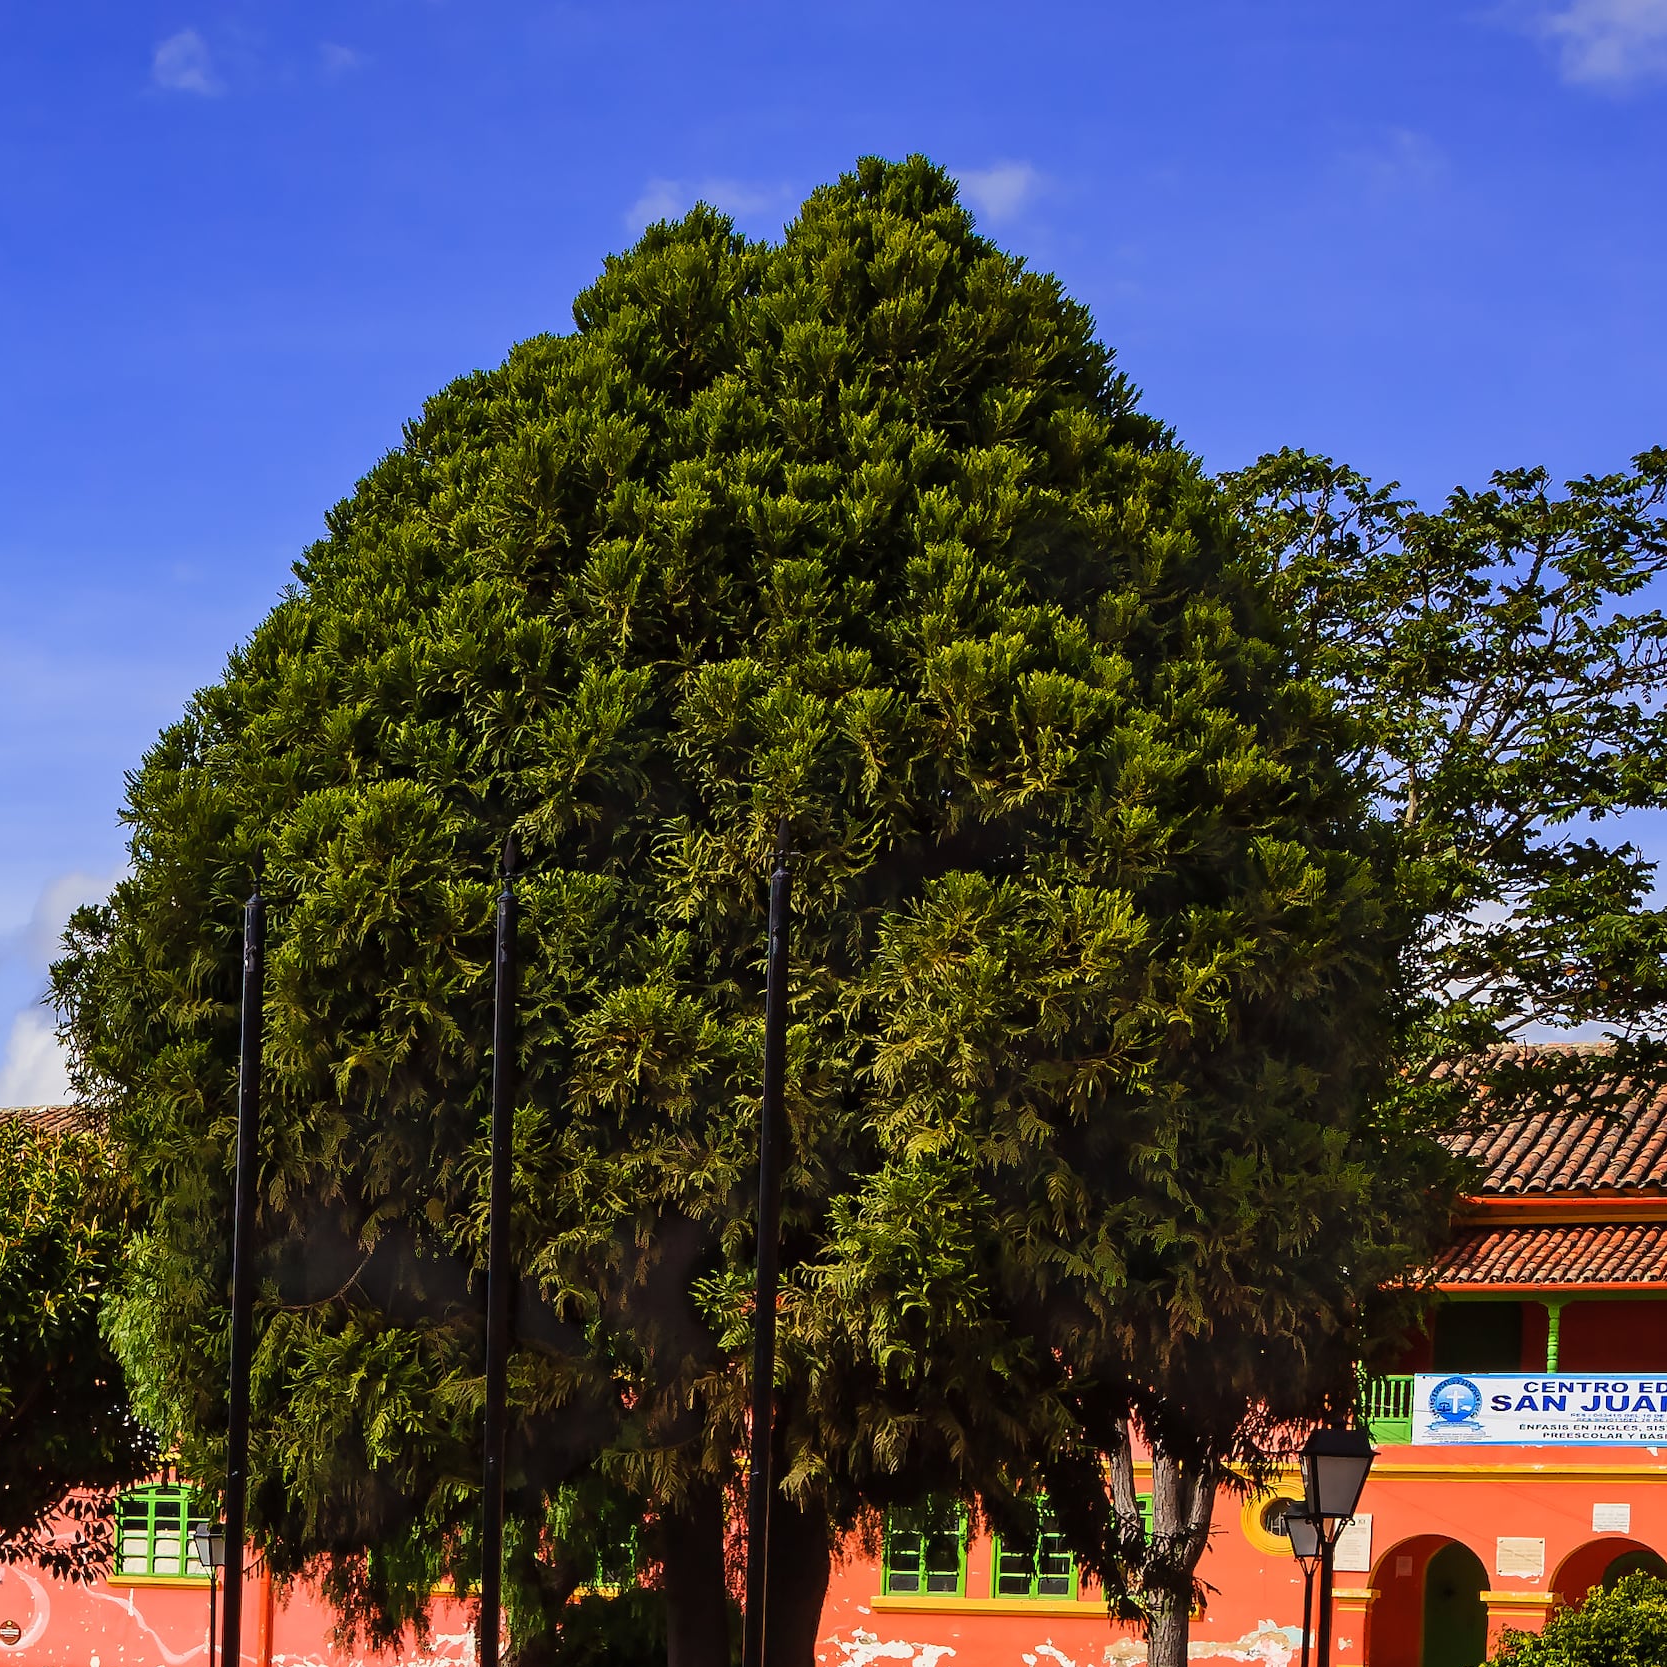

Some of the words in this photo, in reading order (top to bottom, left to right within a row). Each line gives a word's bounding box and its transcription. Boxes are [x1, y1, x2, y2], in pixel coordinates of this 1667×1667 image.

[1523, 1381, 1629, 1393] CENTRO
[1490, 1394, 1567, 1412] SAN
[1580, 1395, 1667, 1412] JUA
[1542, 1432, 1623, 1440] PREESCOLAR
